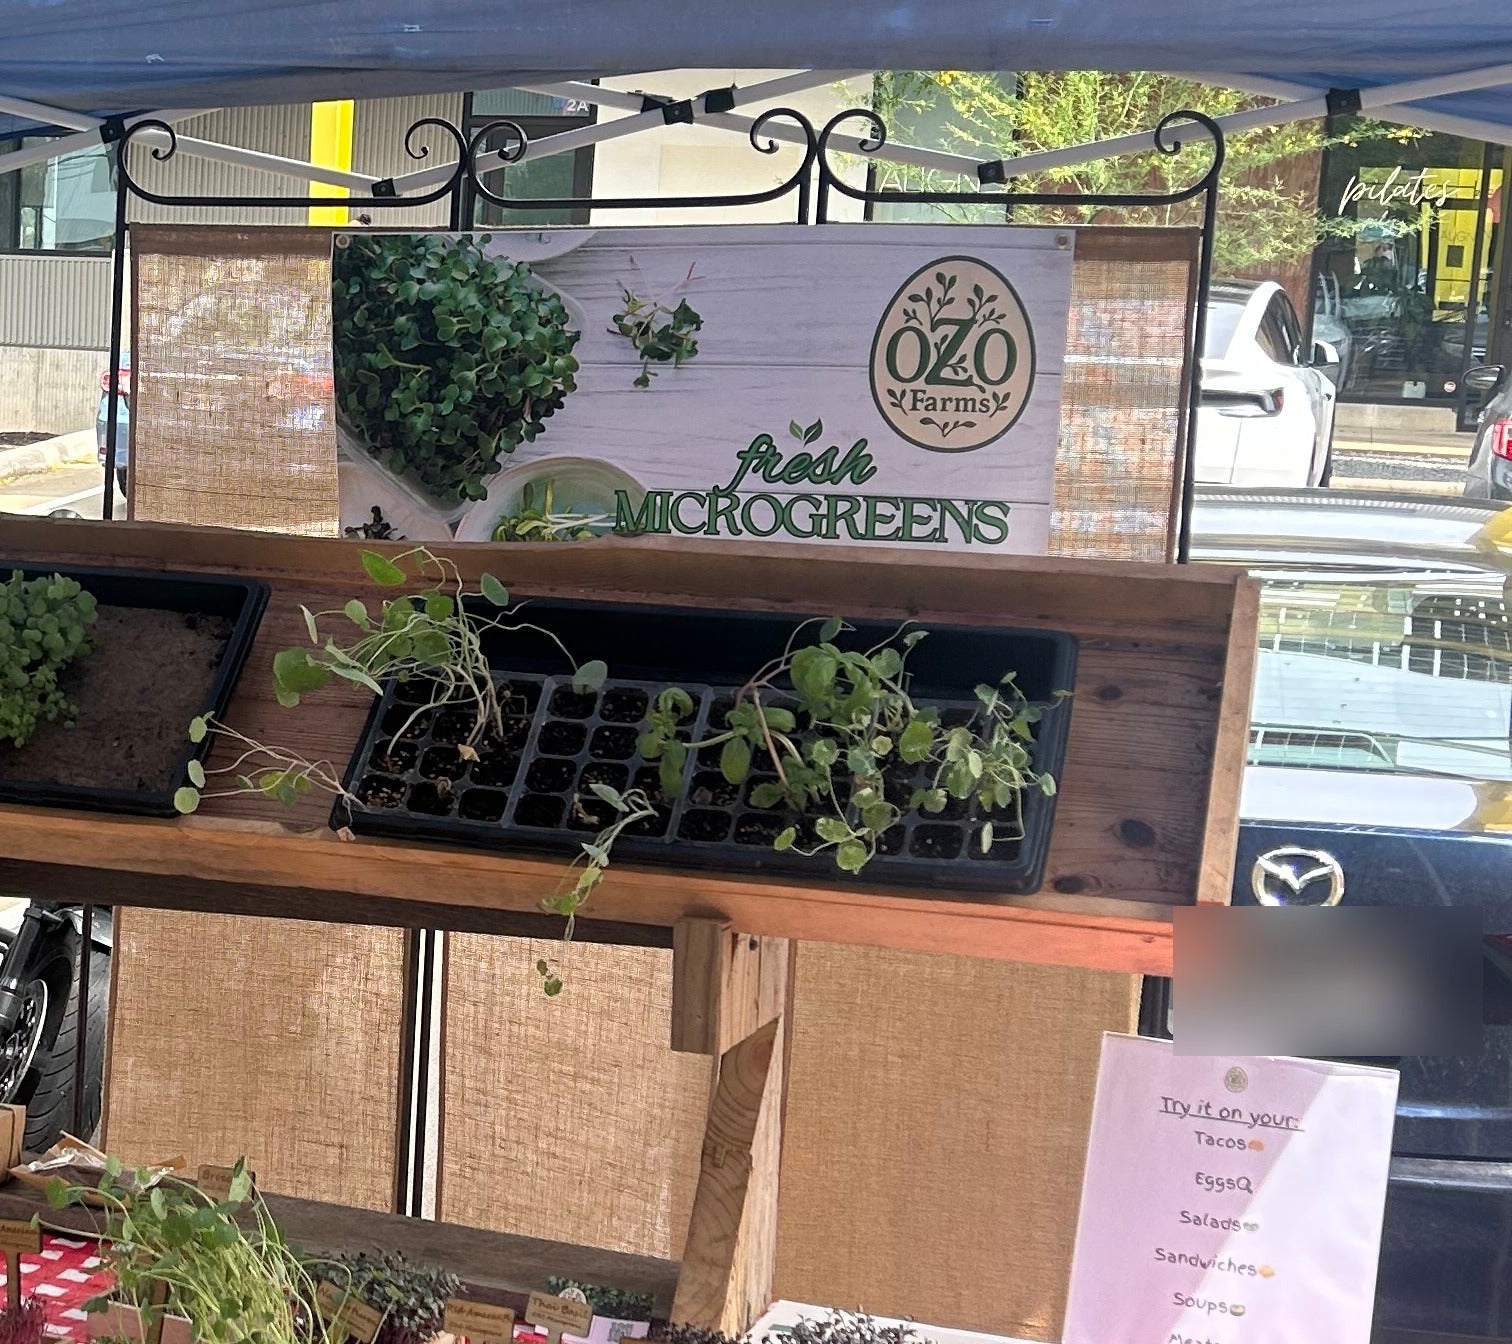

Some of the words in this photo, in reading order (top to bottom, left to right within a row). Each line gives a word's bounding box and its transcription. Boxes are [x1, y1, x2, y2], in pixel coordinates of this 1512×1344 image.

[567, 99, 589, 112] 2A
[1338, 166, 1460, 216] pilates
[886, 317, 1018, 387] OZO
[909, 389, 991, 414] Farms
[713, 433, 878, 494] fresh
[612, 489, 1011, 545] MICROGREENS
[1160, 1096, 1191, 1119] Try
[1197, 1099, 1212, 1116] it
[1219, 1106, 1242, 1120] on
[1194, 1130, 1247, 1151] Tacos
[1179, 1210, 1242, 1232] Salads
[1153, 1247, 1258, 1277] Sandwiches
[1172, 1292, 1228, 1316] Soups
